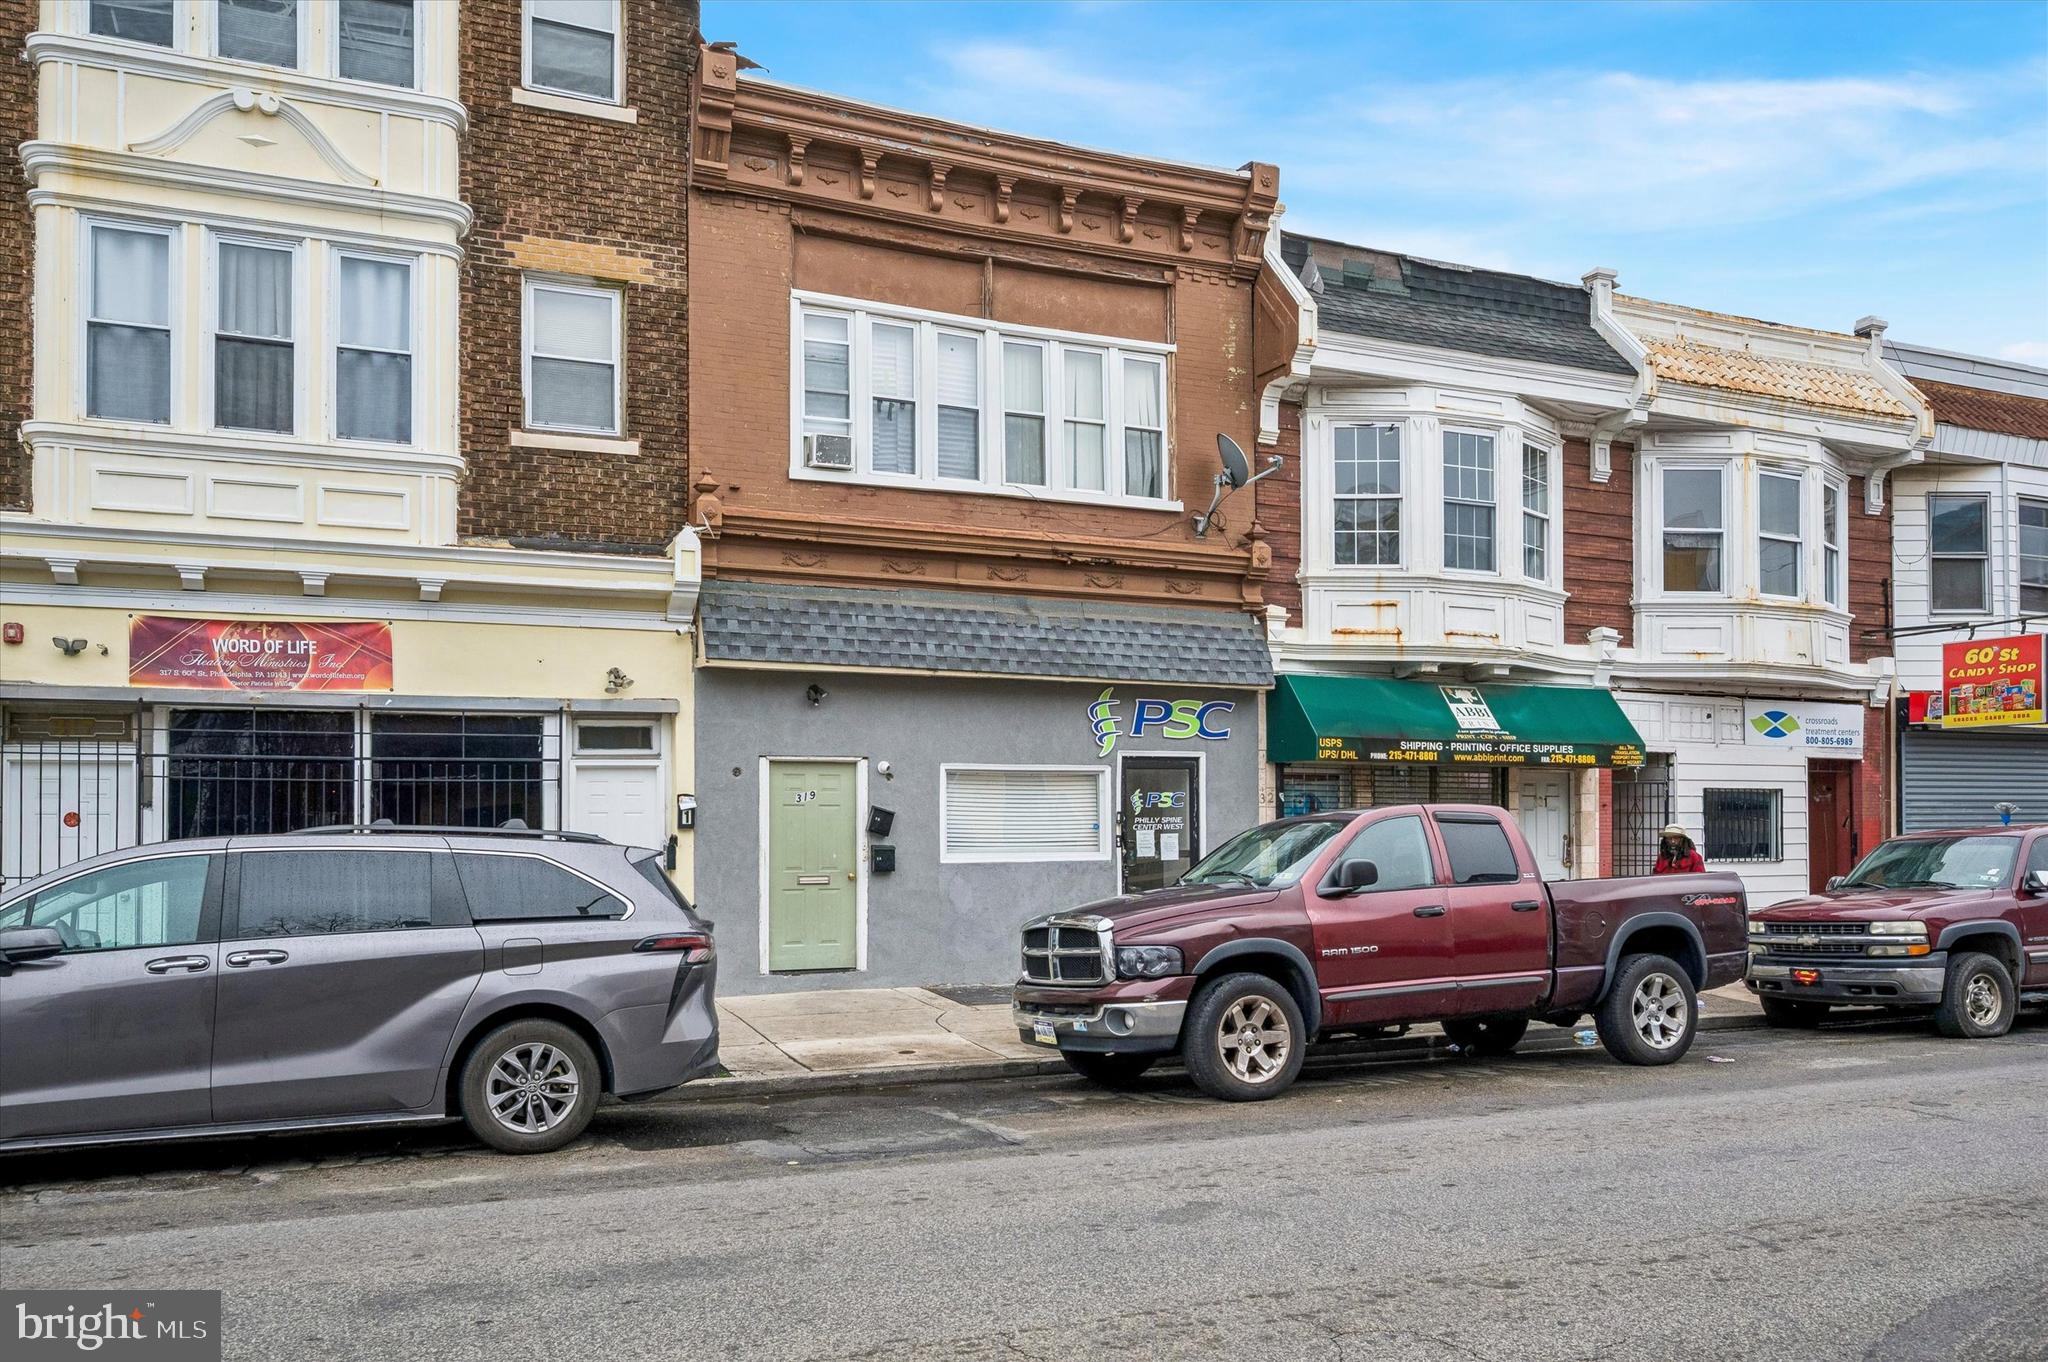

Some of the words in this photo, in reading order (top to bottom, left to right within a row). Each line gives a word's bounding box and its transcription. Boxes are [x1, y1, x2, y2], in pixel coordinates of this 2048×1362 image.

[212, 638, 260, 653] WORD
[264, 640, 283, 654] OF
[287, 640, 317, 655] LIFE
[179, 649, 237, 671] Healing
[238, 652, 307, 668] Ministries
[1948, 666, 1996, 678] CANDY
[1999, 663, 2037, 675] SHOP
[1456, 707, 1491, 718] ABBI
[1129, 698, 1235, 739] PSC
[1805, 717, 1838, 725] crossroads
[1319, 738, 1342, 748] USPS
[1805, 737, 1853, 746] 800-805-6989
[1400, 741, 1443, 751] SHIPPING
[1450, 742, 1493, 752] PRINTING
[1499, 744, 1531, 753] OFFICE
[1532, 744, 1574, 754] SUPPLIES
[1341, 751, 1358, 759] DHL
[1454, 753, 1525, 763] www.abbiprint.com
[796, 790, 816, 803] 319
[1145, 791, 1186, 808] PSC
[1161, 816, 1183, 824] SPINE
[1132, 823, 1163, 831] CENTER
[1322, 948, 1348, 957] RAM
[1350, 945, 1379, 954] 1500
